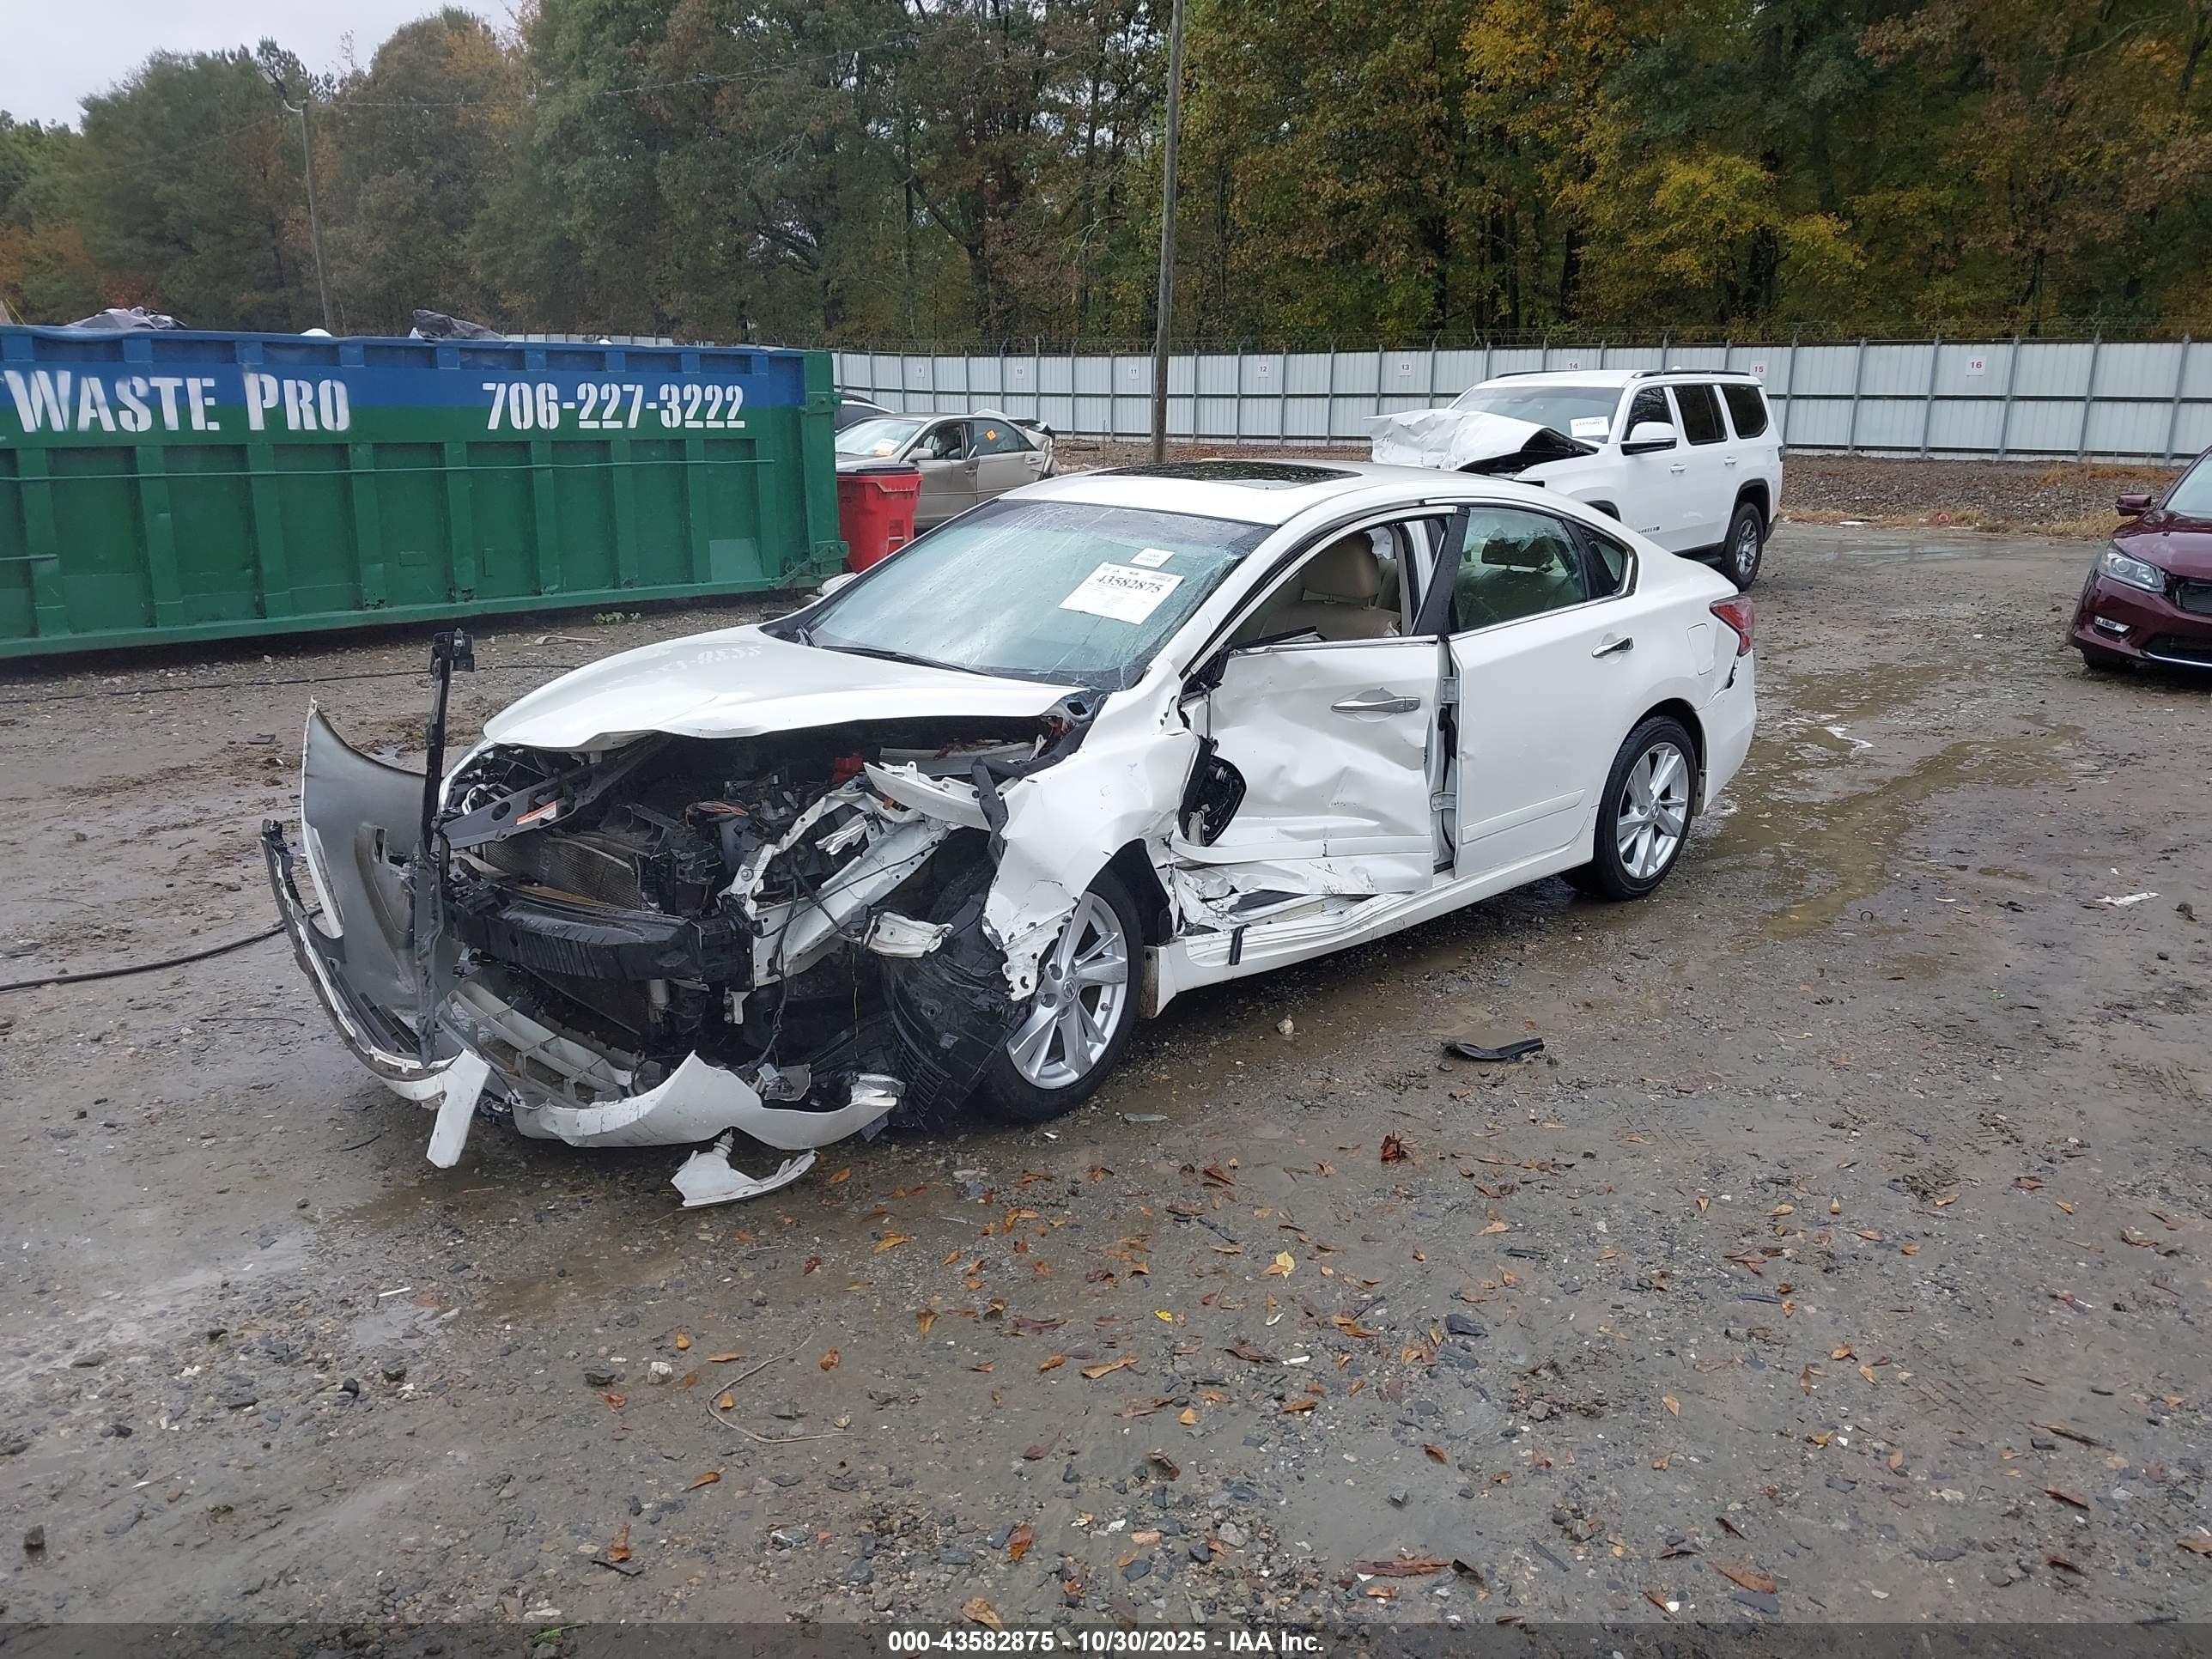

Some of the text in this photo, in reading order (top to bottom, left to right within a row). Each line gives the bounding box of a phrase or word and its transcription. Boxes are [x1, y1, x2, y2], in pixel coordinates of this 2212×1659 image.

[1568, 362, 1579, 370] 14
[1753, 365, 1765, 374] 15
[1970, 361, 1983, 369] 16
[4, 370, 350, 433] WASTE PRO
[482, 382, 745, 430] 706-227-3222
[1097, 574, 1164, 593] 43582875
